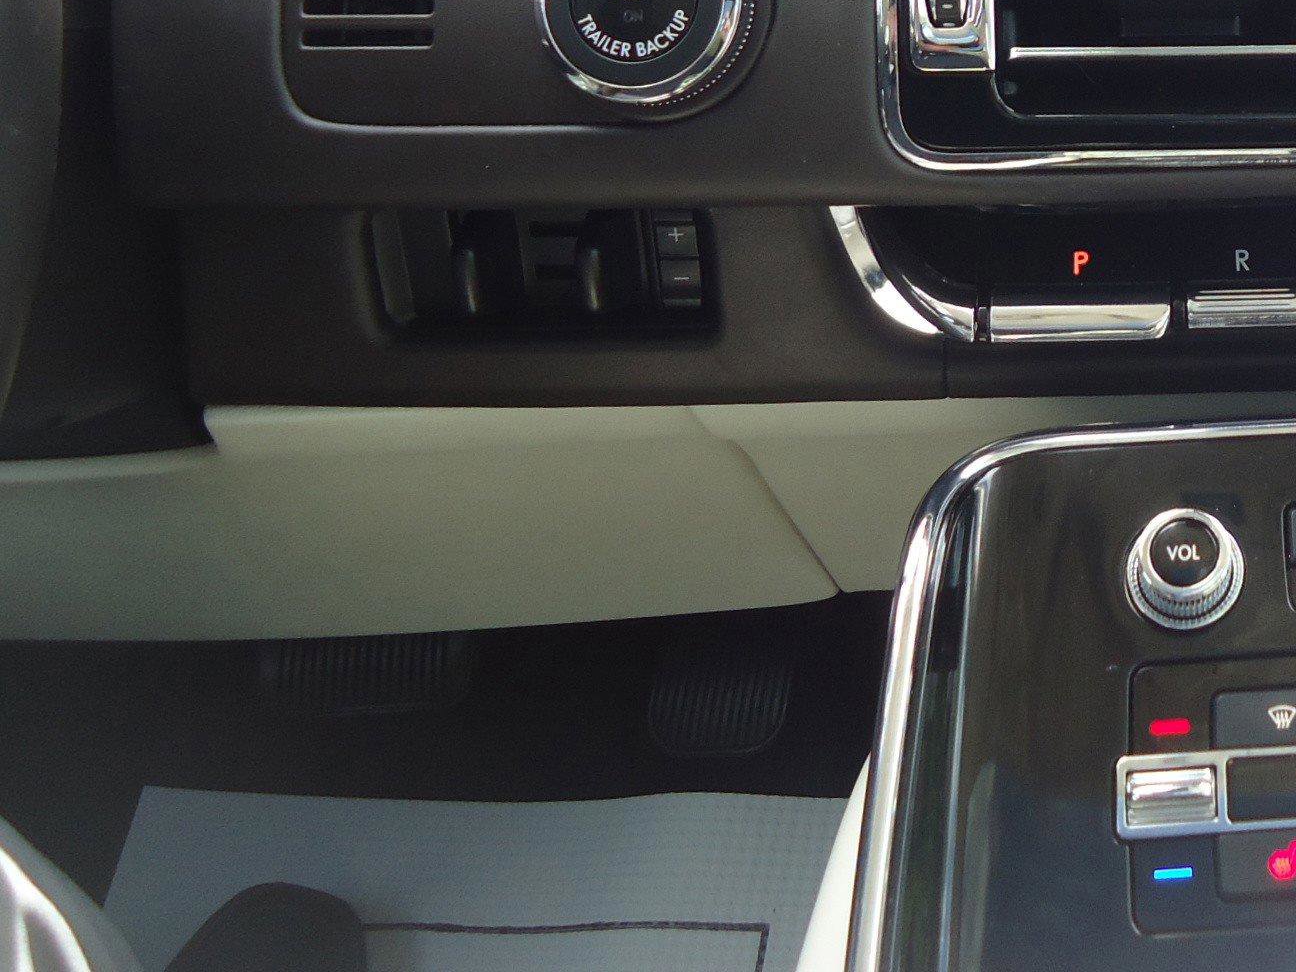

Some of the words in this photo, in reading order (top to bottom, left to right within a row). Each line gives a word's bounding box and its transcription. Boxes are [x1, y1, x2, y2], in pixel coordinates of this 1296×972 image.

[578, 13, 631, 58] TRAILER
[635, 9, 689, 57] BACKUP
[1072, 250, 1089, 277] P
[1234, 248, 1251, 273] R
[1166, 544, 1201, 563] VOL
